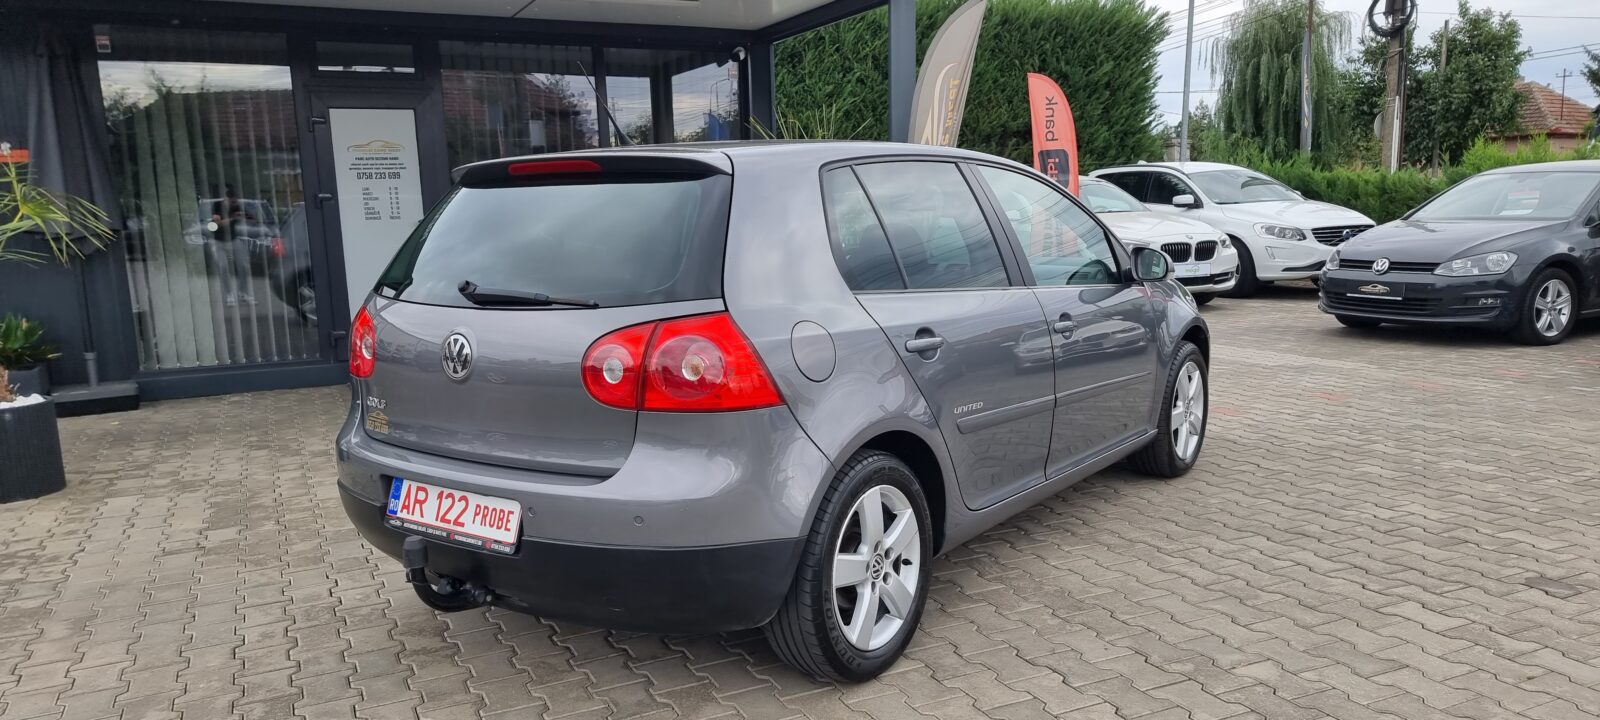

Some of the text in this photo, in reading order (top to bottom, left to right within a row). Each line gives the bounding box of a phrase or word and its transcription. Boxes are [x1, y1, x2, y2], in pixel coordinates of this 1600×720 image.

[953, 401, 984, 414] UNITED
[389, 498, 399, 512] RO
[400, 484, 429, 518] AR
[435, 490, 469, 527] 122
[472, 503, 515, 532] PROBE
